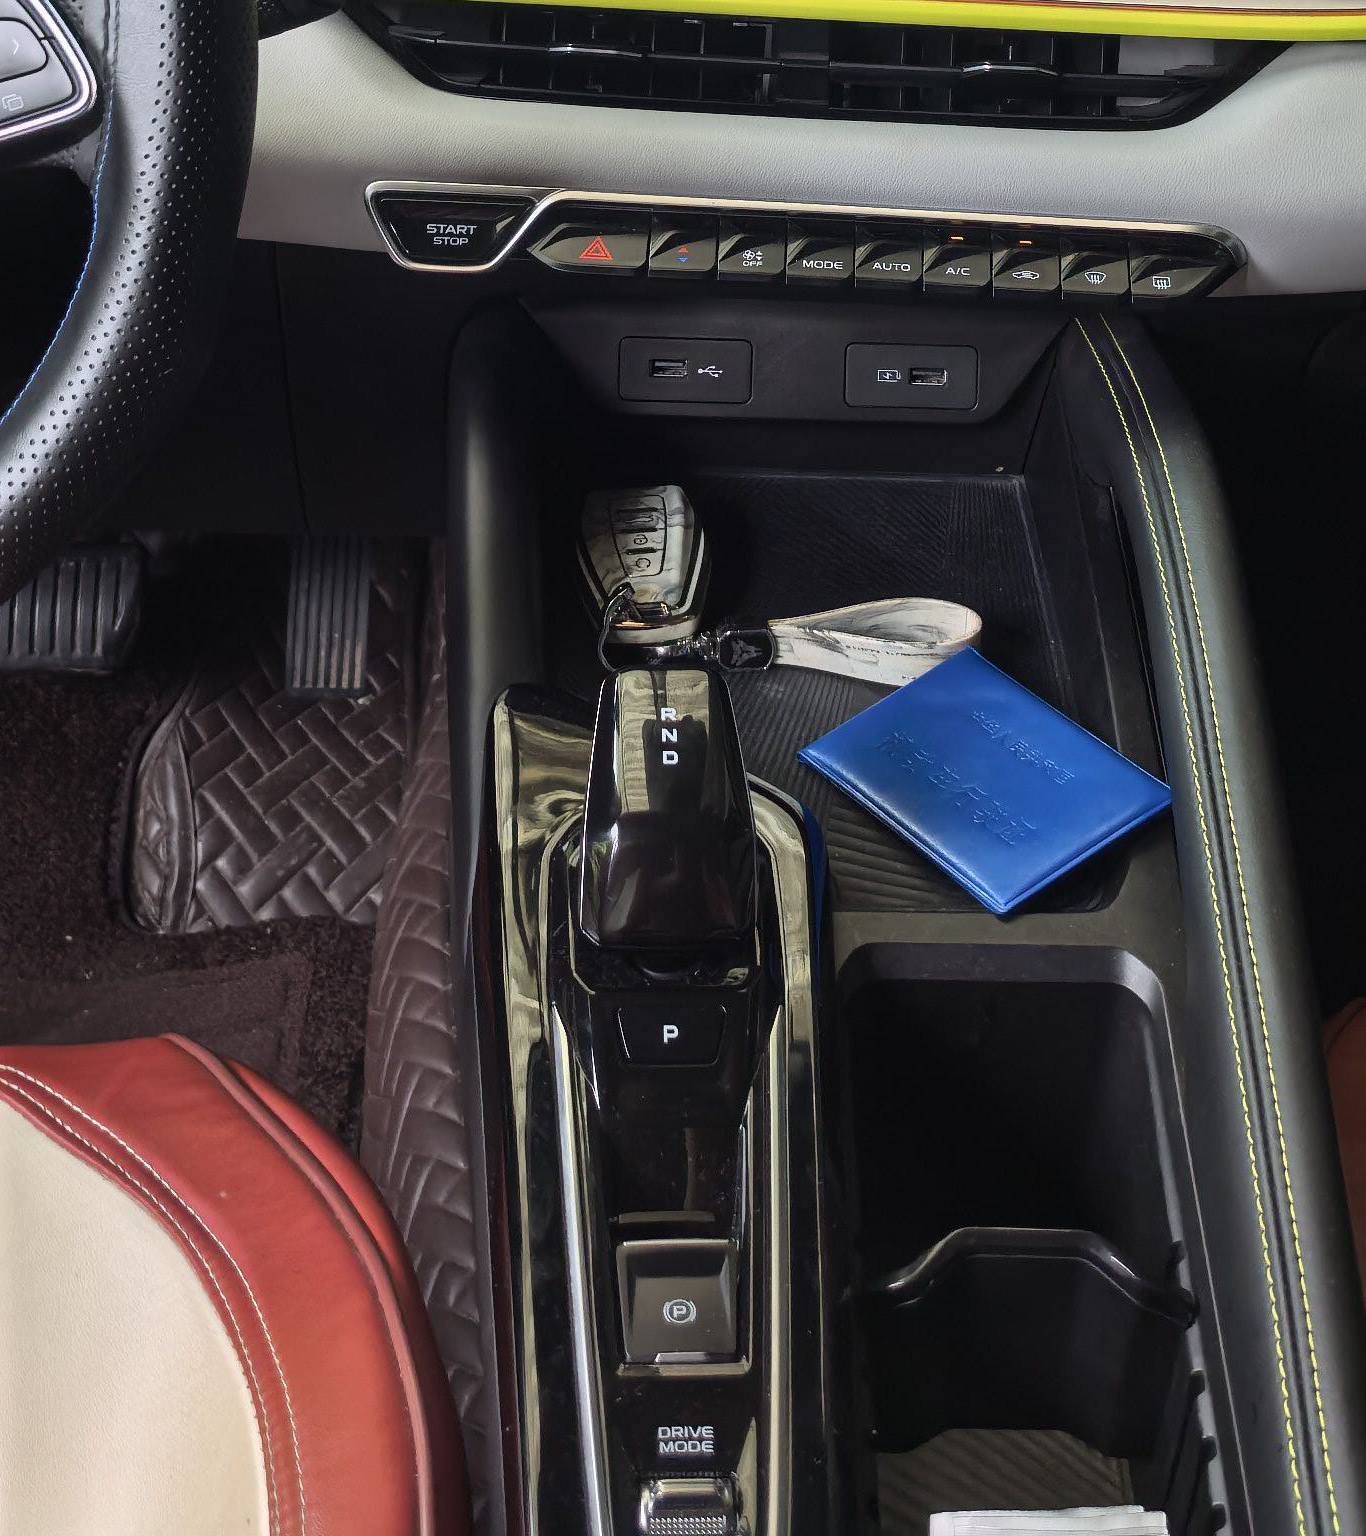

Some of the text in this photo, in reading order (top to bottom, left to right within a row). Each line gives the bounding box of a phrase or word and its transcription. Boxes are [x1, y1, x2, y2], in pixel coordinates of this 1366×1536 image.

[426, 223, 478, 236] START
[432, 235, 469, 246] STOP
[742, 259, 763, 268] OFF
[801, 258, 844, 270] MODE
[872, 261, 912, 272] AUTO
[945, 265, 971, 277] A/C
[660, 706, 678, 722] R
[661, 727, 678, 743] N
[662, 750, 679, 765] D
[663, 1024, 679, 1044] P
[657, 1425, 715, 1439] DRIVE
[658, 1439, 715, 1454] MODE
